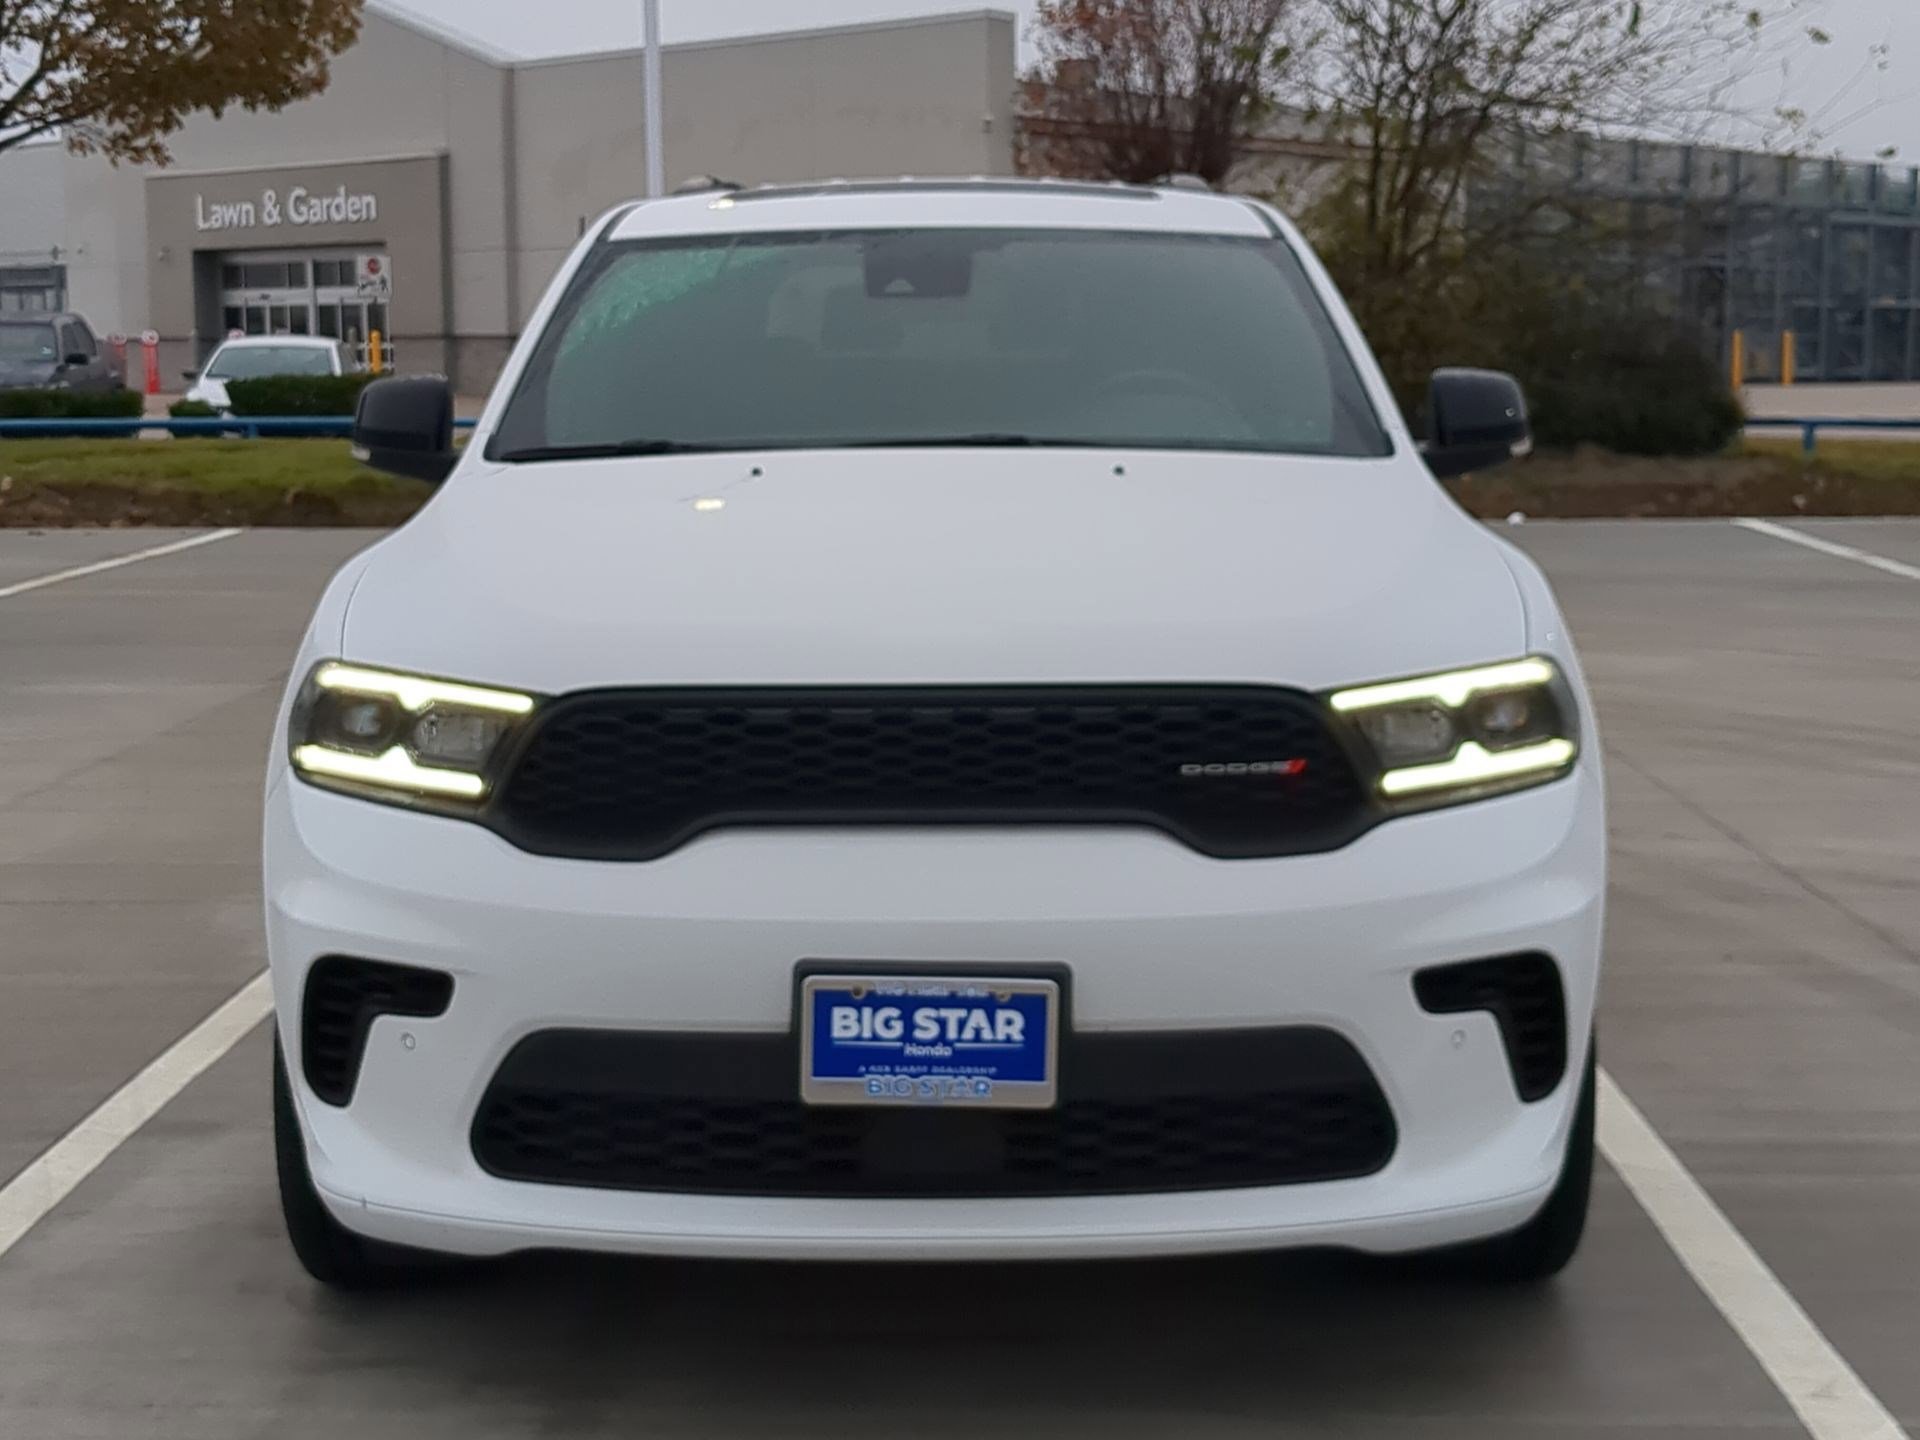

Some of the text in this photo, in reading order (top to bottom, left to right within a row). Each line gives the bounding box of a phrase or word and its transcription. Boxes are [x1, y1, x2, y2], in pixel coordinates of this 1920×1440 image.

[197, 185, 376, 231] Lawn & Garden
[1181, 761, 1291, 775] DODGE
[831, 1006, 1025, 1041] BIG STAR
[904, 1042, 953, 1057] Honda
[864, 1075, 992, 1098] BIG STAR
